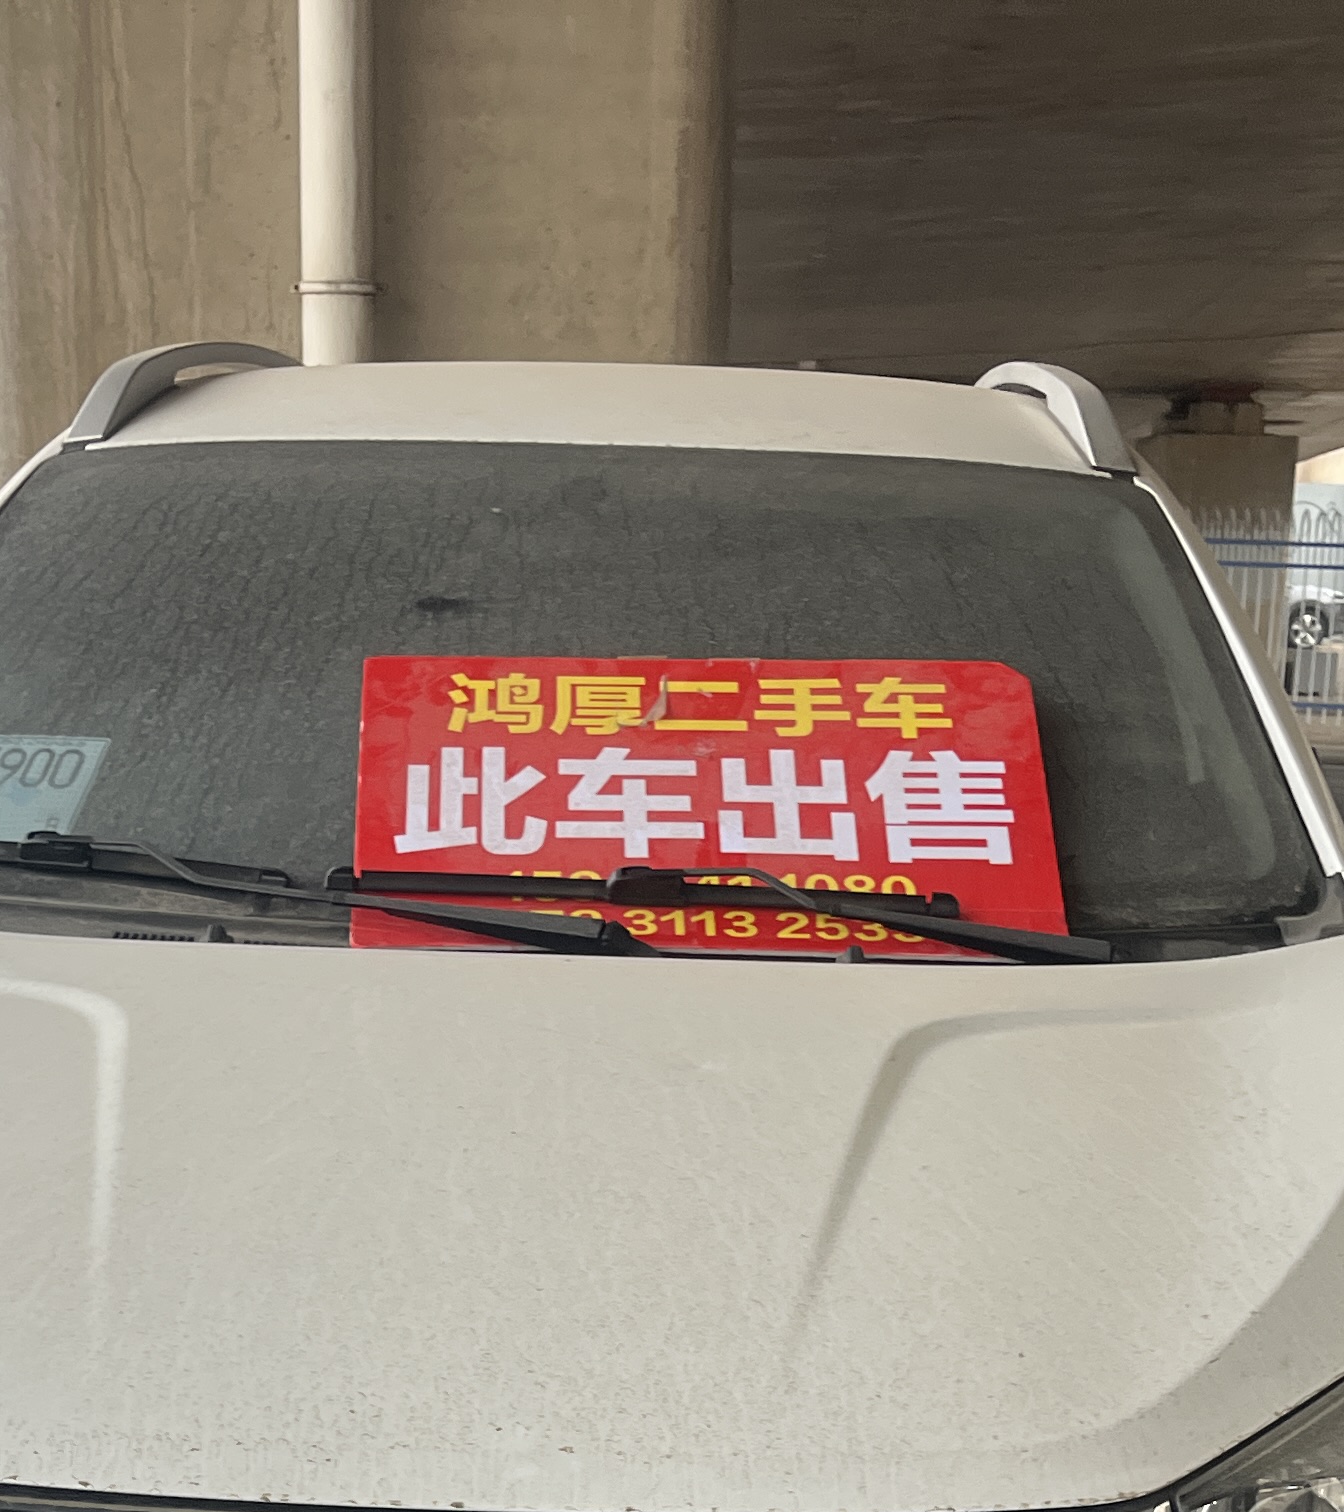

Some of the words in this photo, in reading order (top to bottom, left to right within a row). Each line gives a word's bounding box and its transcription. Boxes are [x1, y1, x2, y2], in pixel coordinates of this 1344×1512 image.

[447, 673, 954, 739] 鸿厚二手车
[393, 746, 1016, 865] 此车出售
[623, 908, 759, 938] 3113
